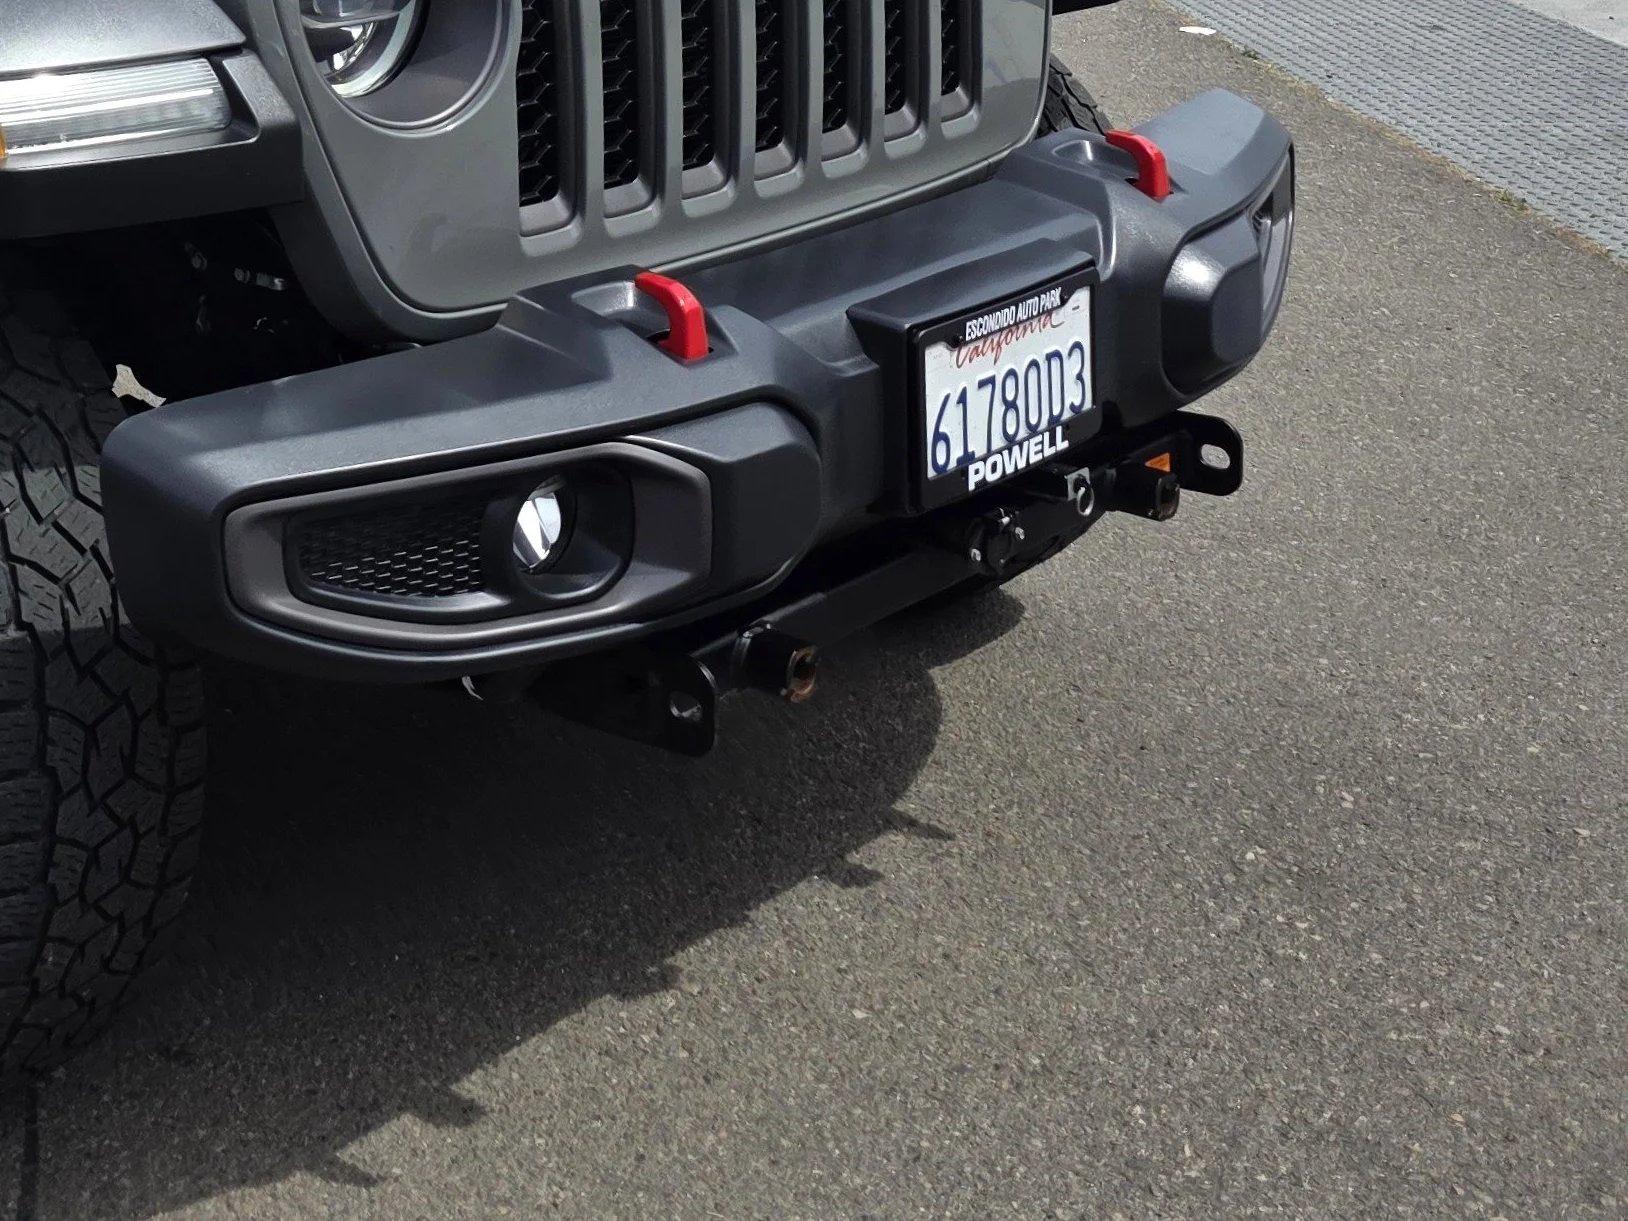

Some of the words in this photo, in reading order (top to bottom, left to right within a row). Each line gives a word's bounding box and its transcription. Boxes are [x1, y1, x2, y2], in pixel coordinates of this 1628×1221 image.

[965, 305, 1016, 341] ESCONDIDO
[1016, 296, 1039, 322] AUTO
[1040, 286, 1062, 311] PARK
[931, 340, 1086, 475] 61780D3
[967, 425, 1069, 492] POWELL
